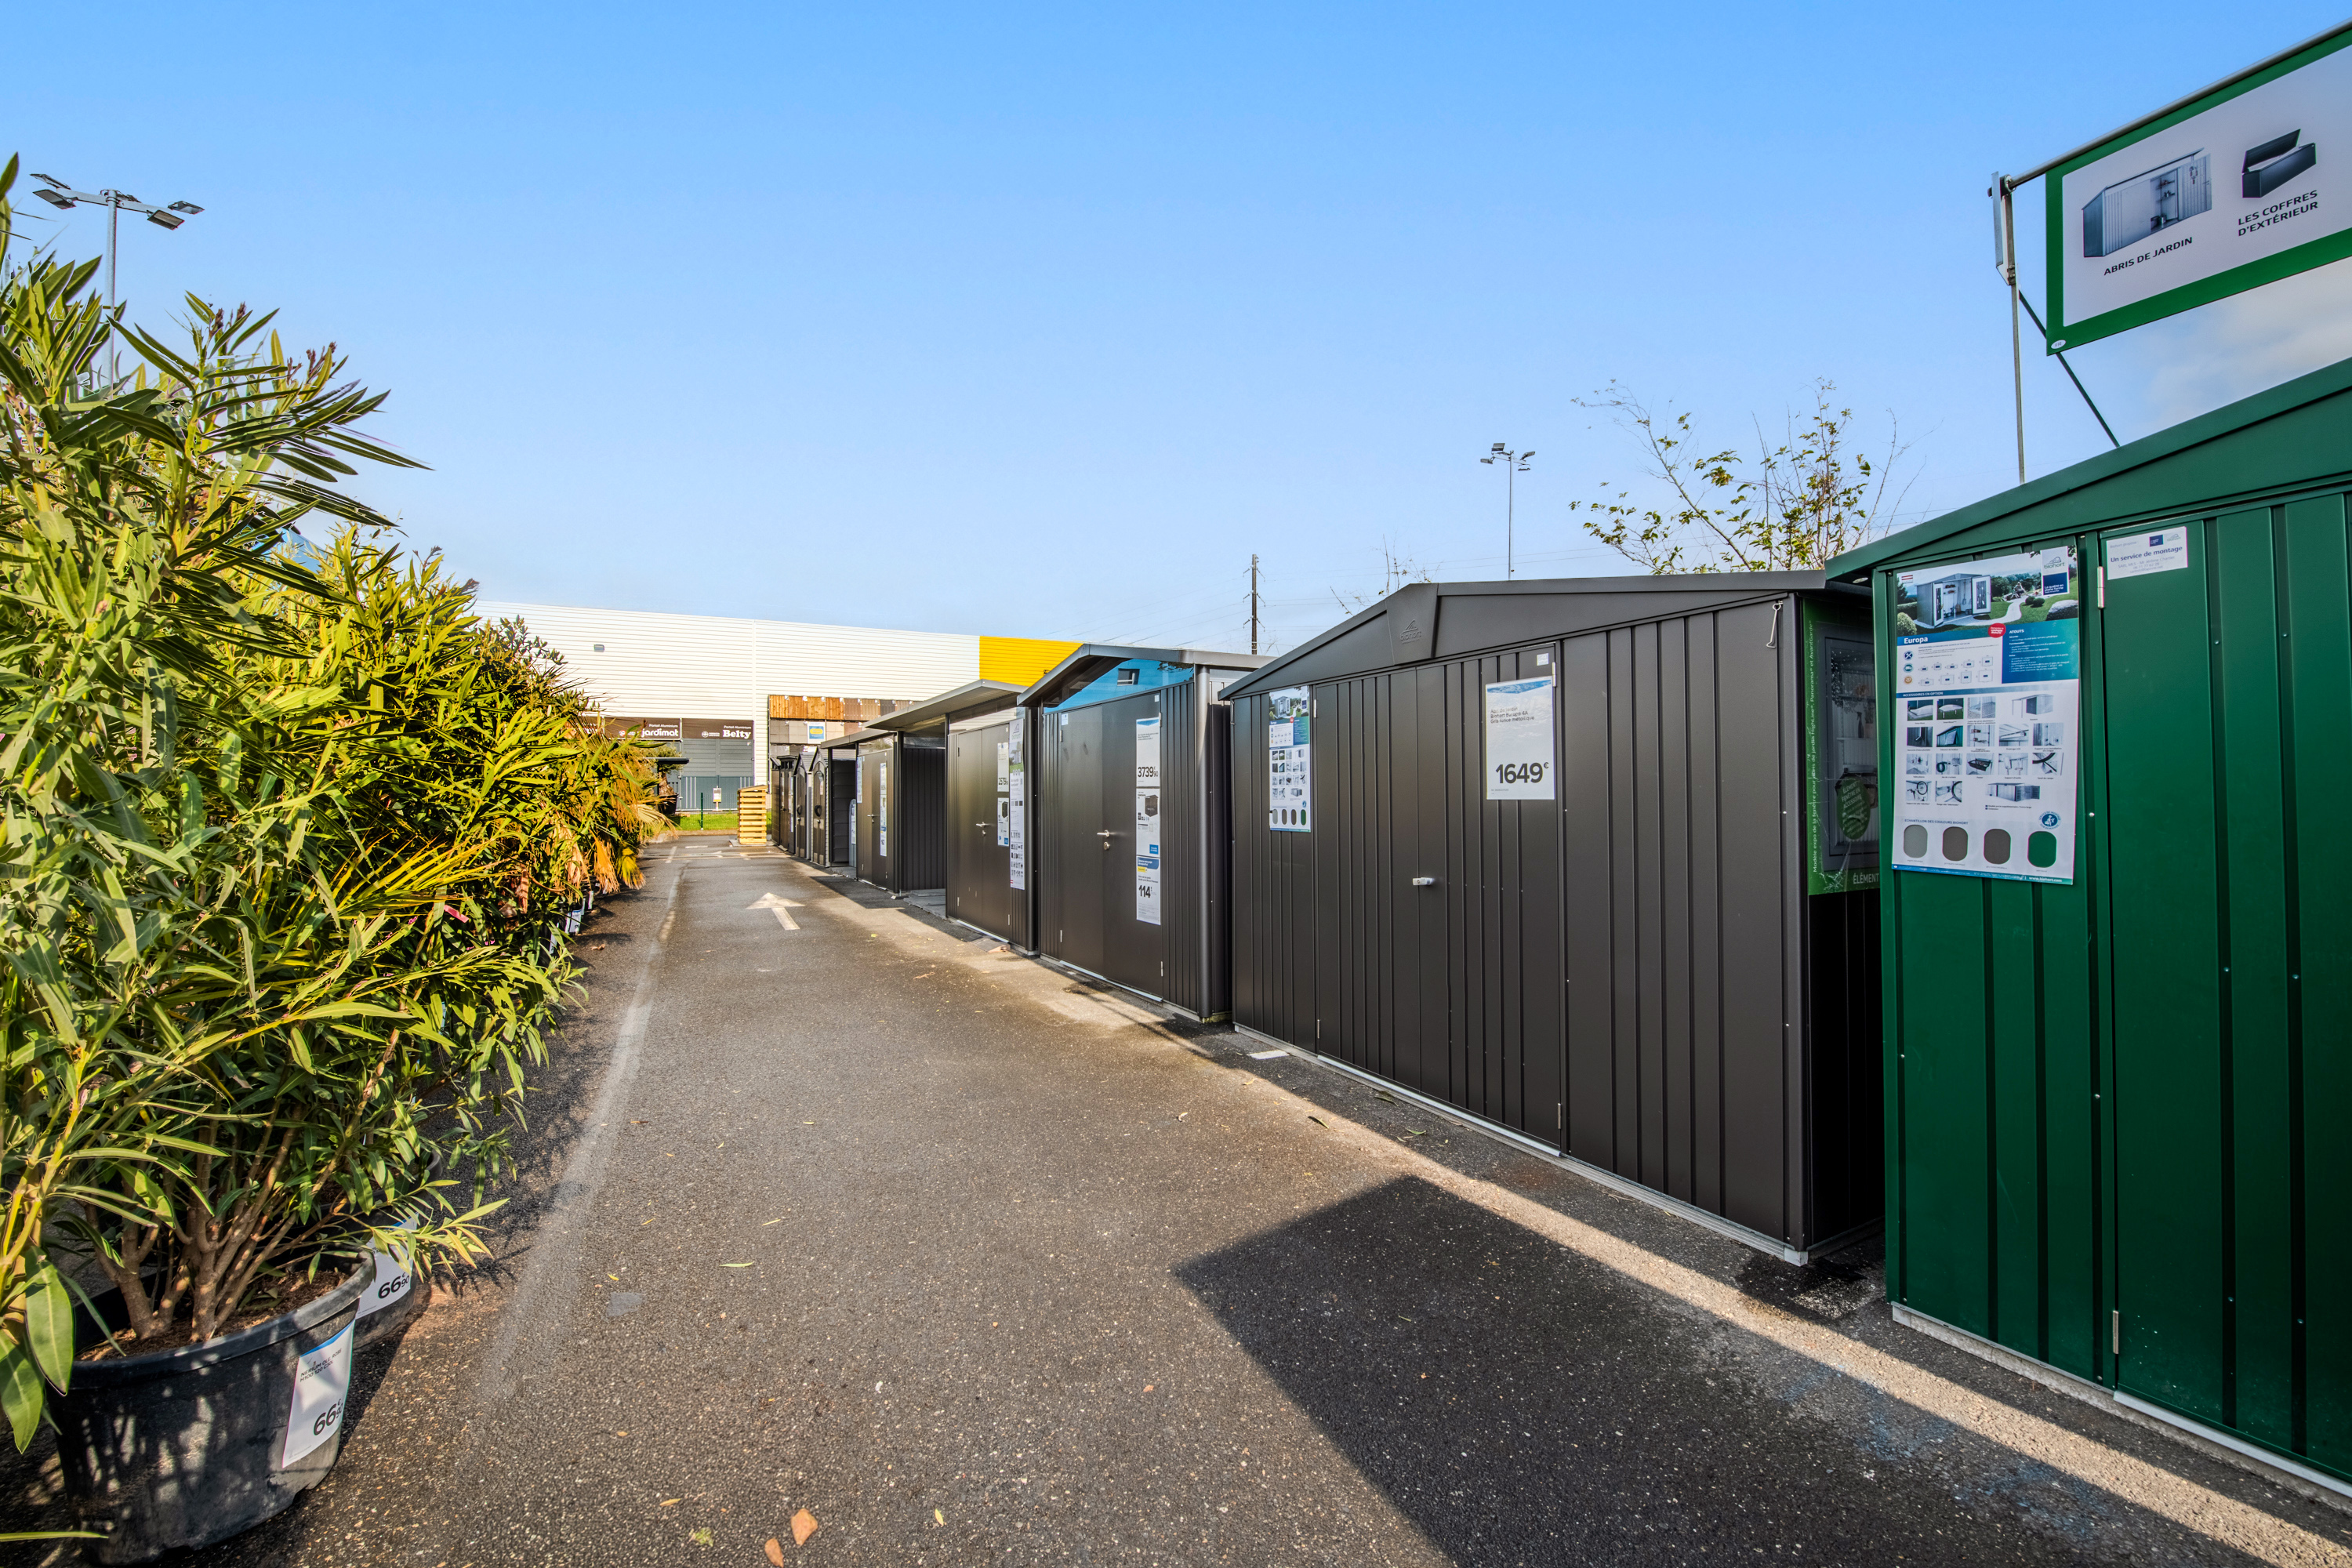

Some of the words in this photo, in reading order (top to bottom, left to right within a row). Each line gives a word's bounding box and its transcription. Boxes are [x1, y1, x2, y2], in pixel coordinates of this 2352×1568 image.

[2238, 212, 2259, 225] LES
[2263, 190, 2318, 216] COFFRES
[2238, 201, 2318, 237] D'EXTÉRIEUR
[2103, 260, 2134, 275] ABRIS
[2137, 252, 2151, 263] DE
[2153, 237, 2193, 258] JARDIN
[2153, 546, 2183, 555] montage
[641, 728, 679, 738] jardimat
[722, 729, 751, 739] Belty
[1853, 873, 1879, 884] ÉLÉMENT
[300, 1362, 322, 1377] NERIUM
[332, 1348, 342, 1359] ROSE
[299, 1372, 314, 1382] H100
